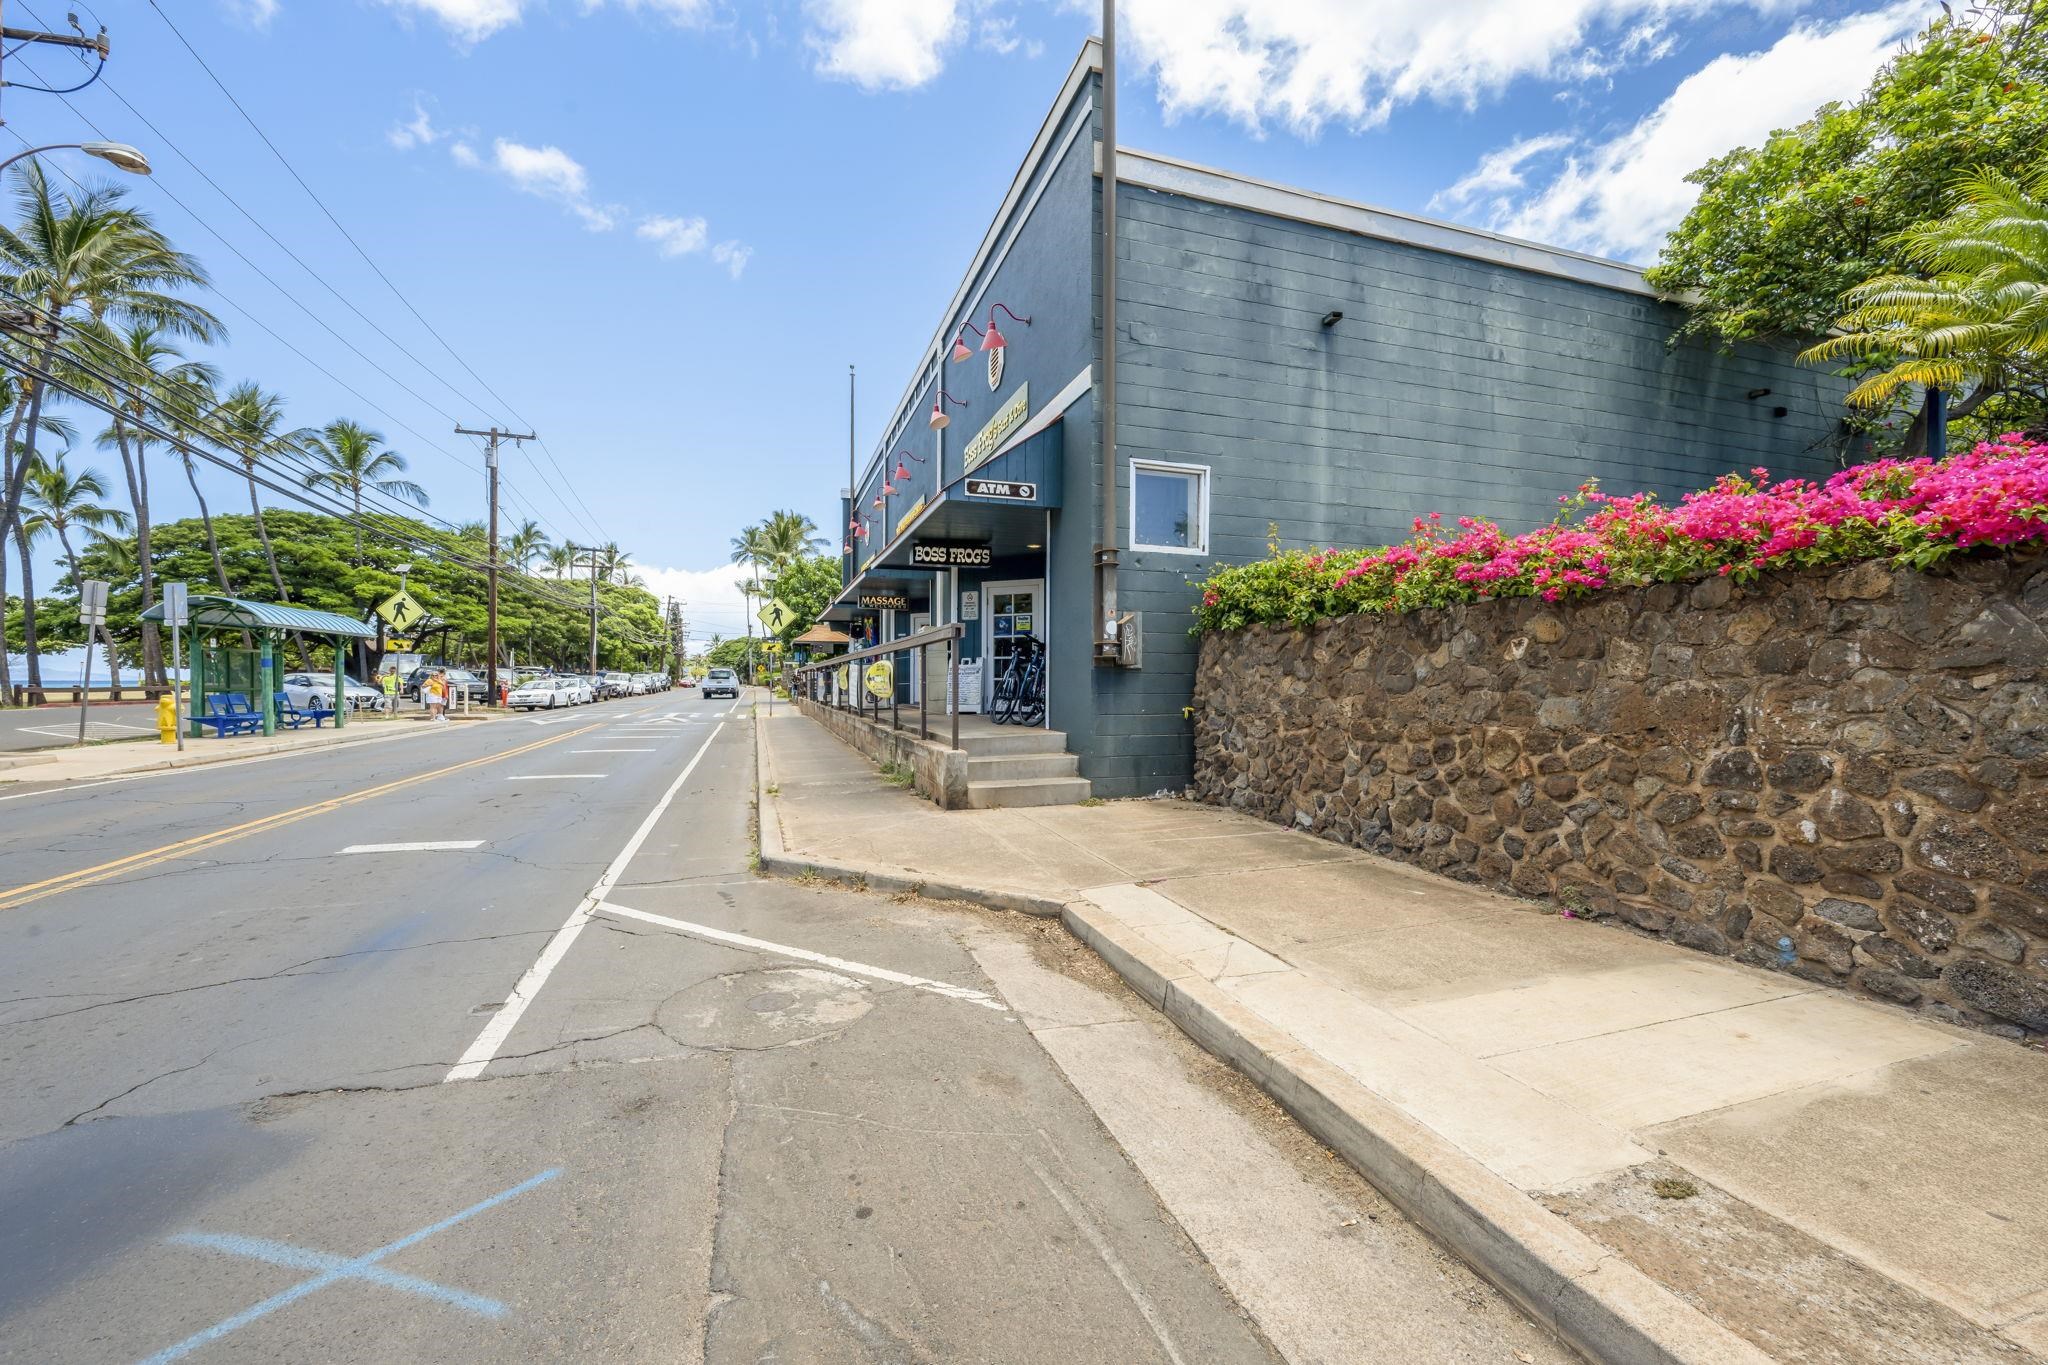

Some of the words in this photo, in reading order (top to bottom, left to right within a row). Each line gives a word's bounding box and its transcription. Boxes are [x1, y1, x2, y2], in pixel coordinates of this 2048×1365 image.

[977, 482, 1011, 495] ATM
[914, 546, 947, 562] BOSS
[861, 596, 906, 605] MASSAGE
